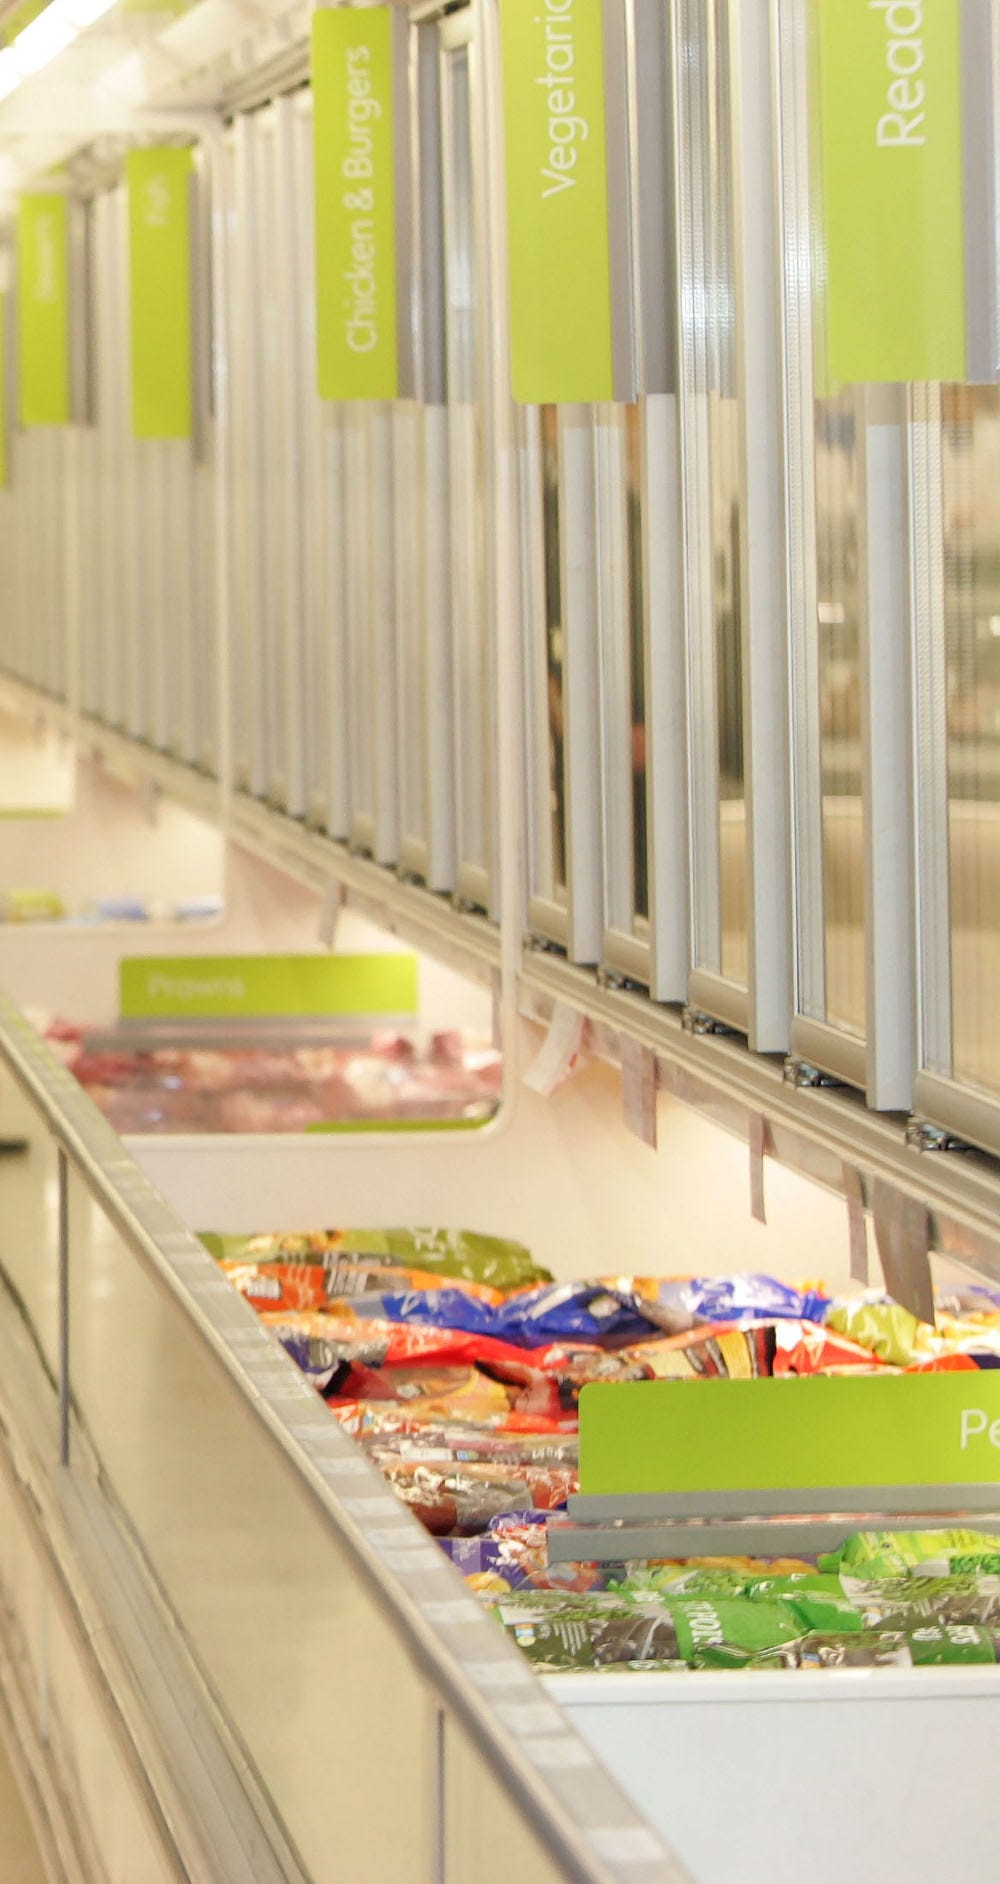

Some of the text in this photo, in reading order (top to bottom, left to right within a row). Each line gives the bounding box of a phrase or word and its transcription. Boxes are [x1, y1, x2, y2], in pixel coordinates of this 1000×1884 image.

[866, 0, 926, 147] Read
[342, 44, 382, 354] Chicken & Burgers
